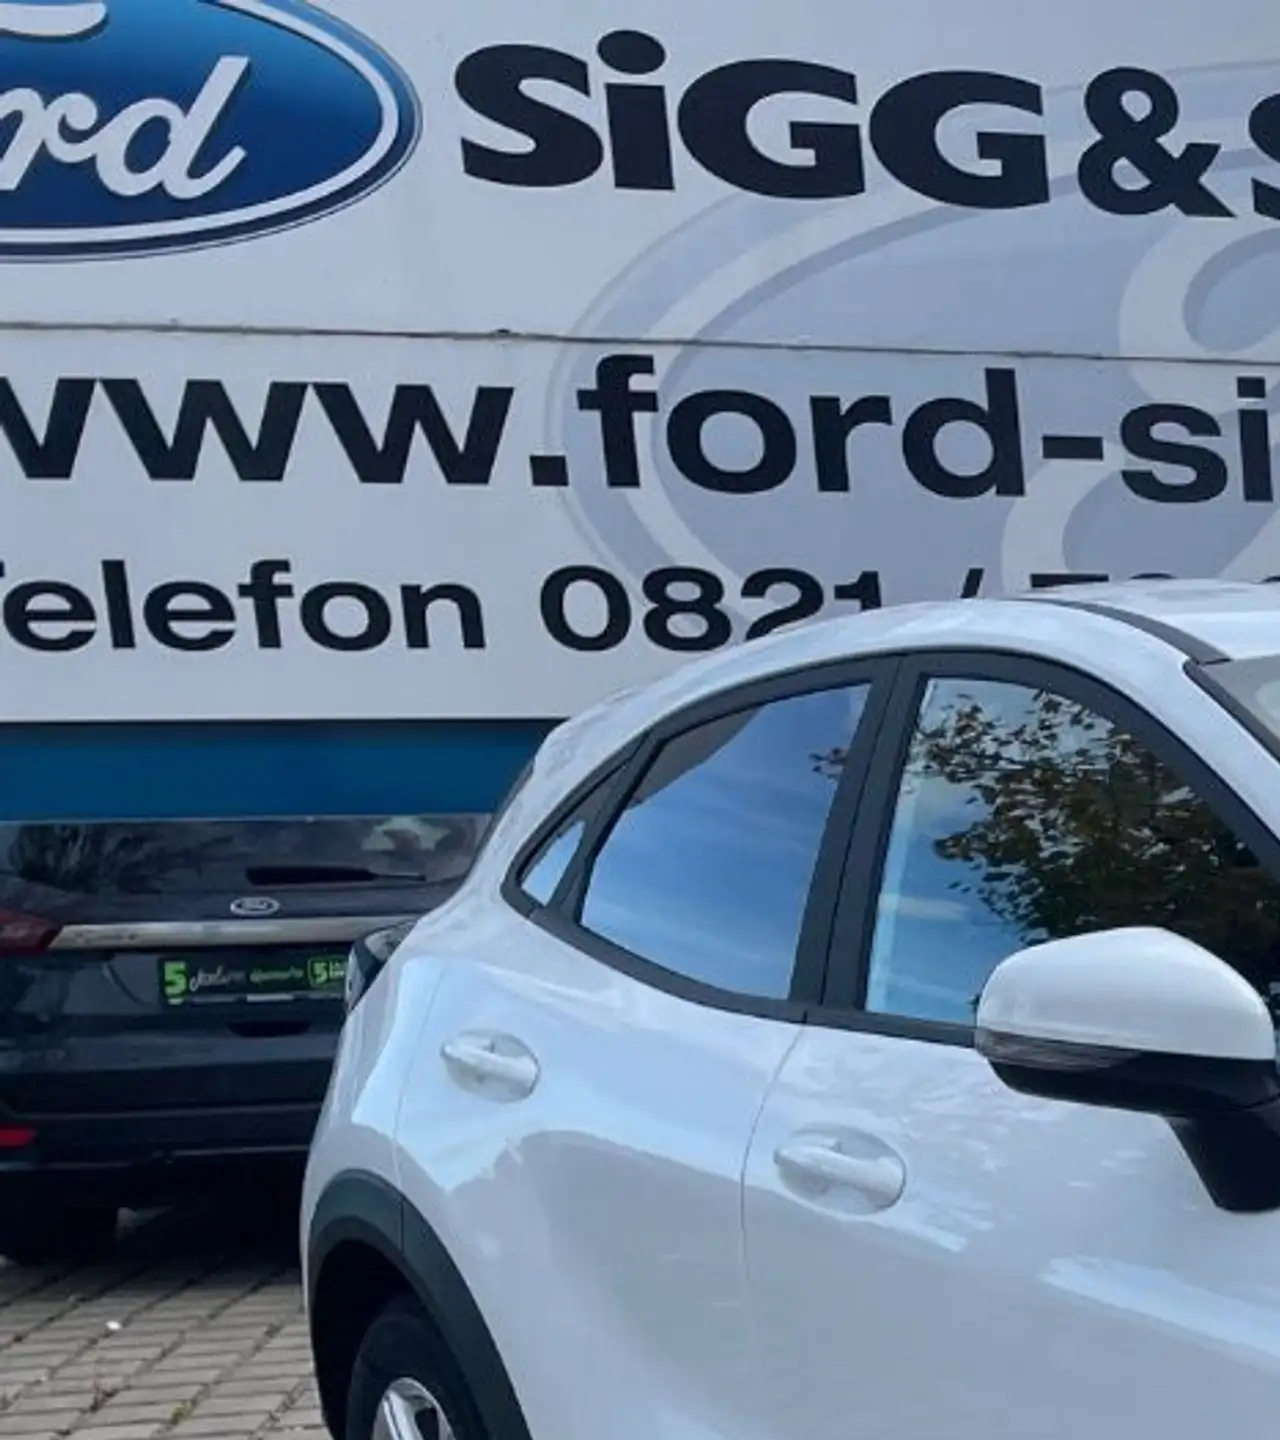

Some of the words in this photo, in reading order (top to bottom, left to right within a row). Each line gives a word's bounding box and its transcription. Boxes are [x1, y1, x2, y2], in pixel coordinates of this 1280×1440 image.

[0, 0, 249, 199] rd
[0, 558, 486, 652] elefon
[164, 961, 187, 994] 5
